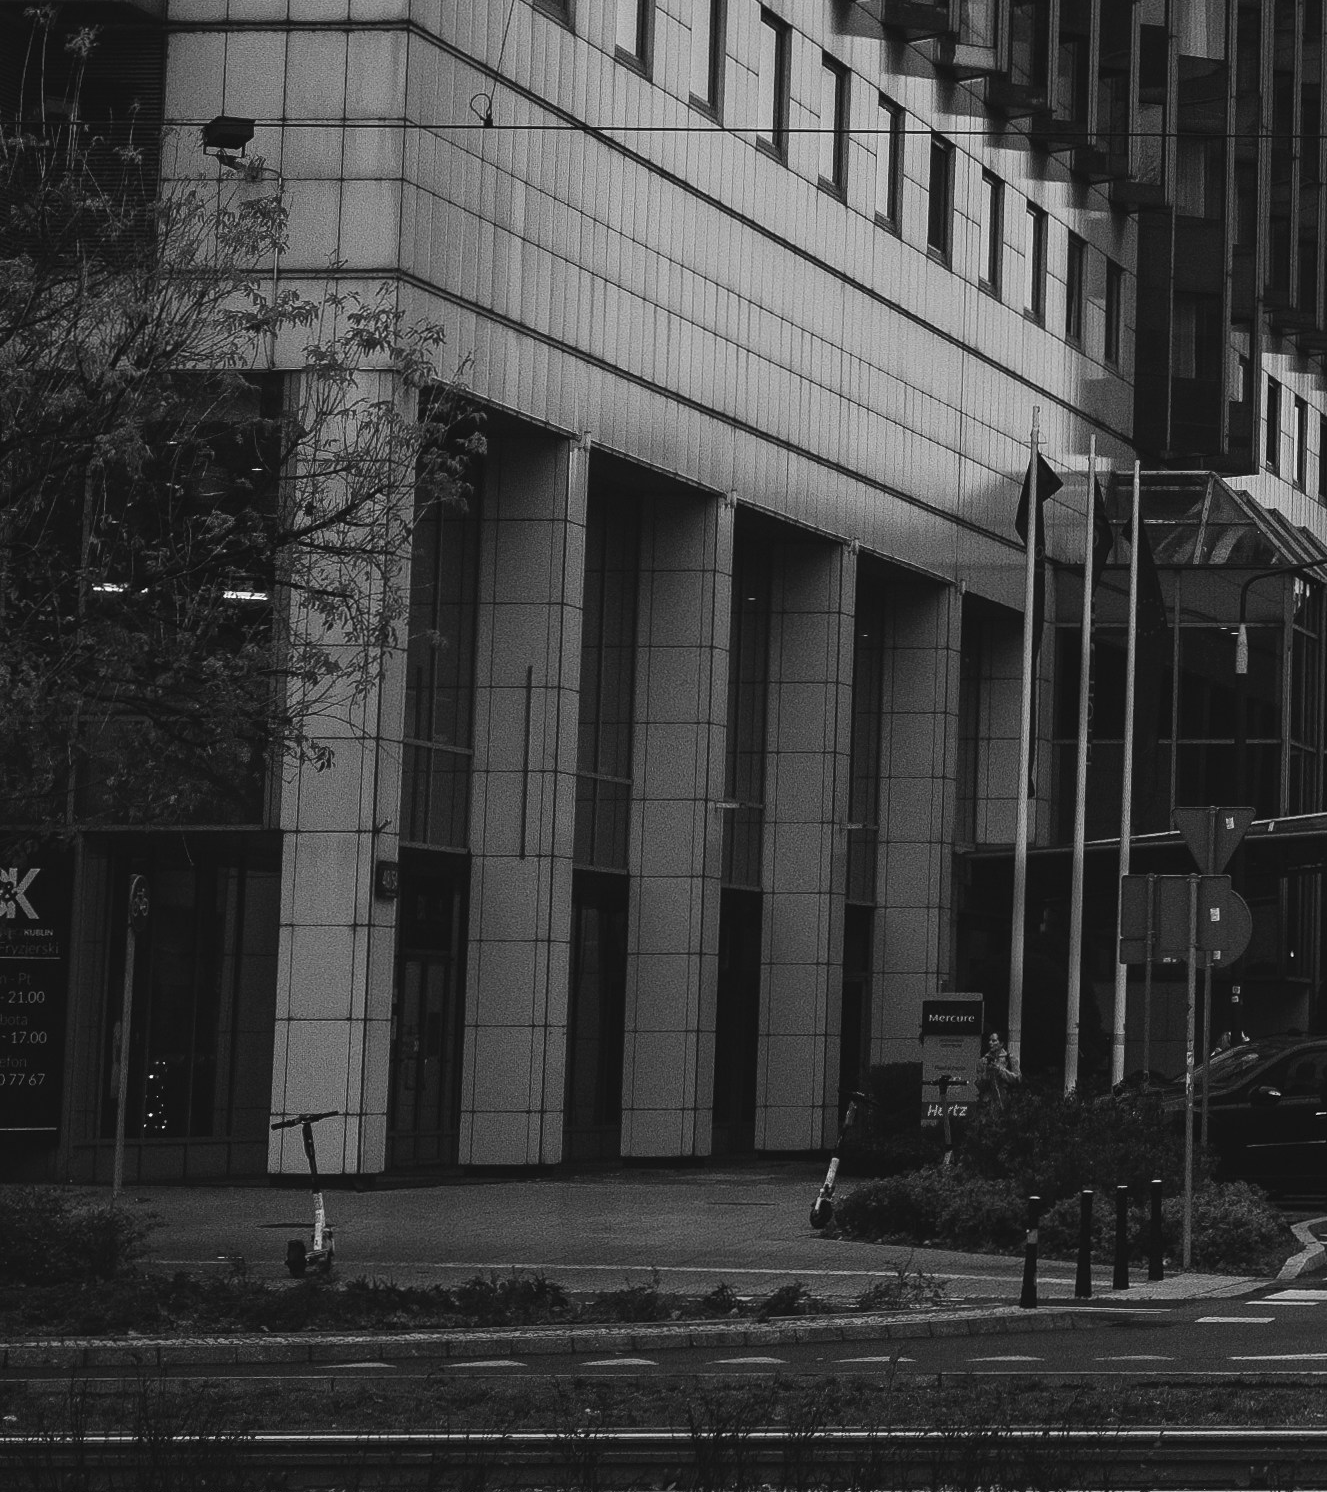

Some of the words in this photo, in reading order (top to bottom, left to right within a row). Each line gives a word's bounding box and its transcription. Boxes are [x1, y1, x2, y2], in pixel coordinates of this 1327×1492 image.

[8, 990, 46, 1004] 21.00
[928, 1014, 975, 1023] Mercure
[11, 1031, 48, 1044] 17.00
[9, 1073, 26, 1086] 77
[29, 1073, 46, 1086] 67
